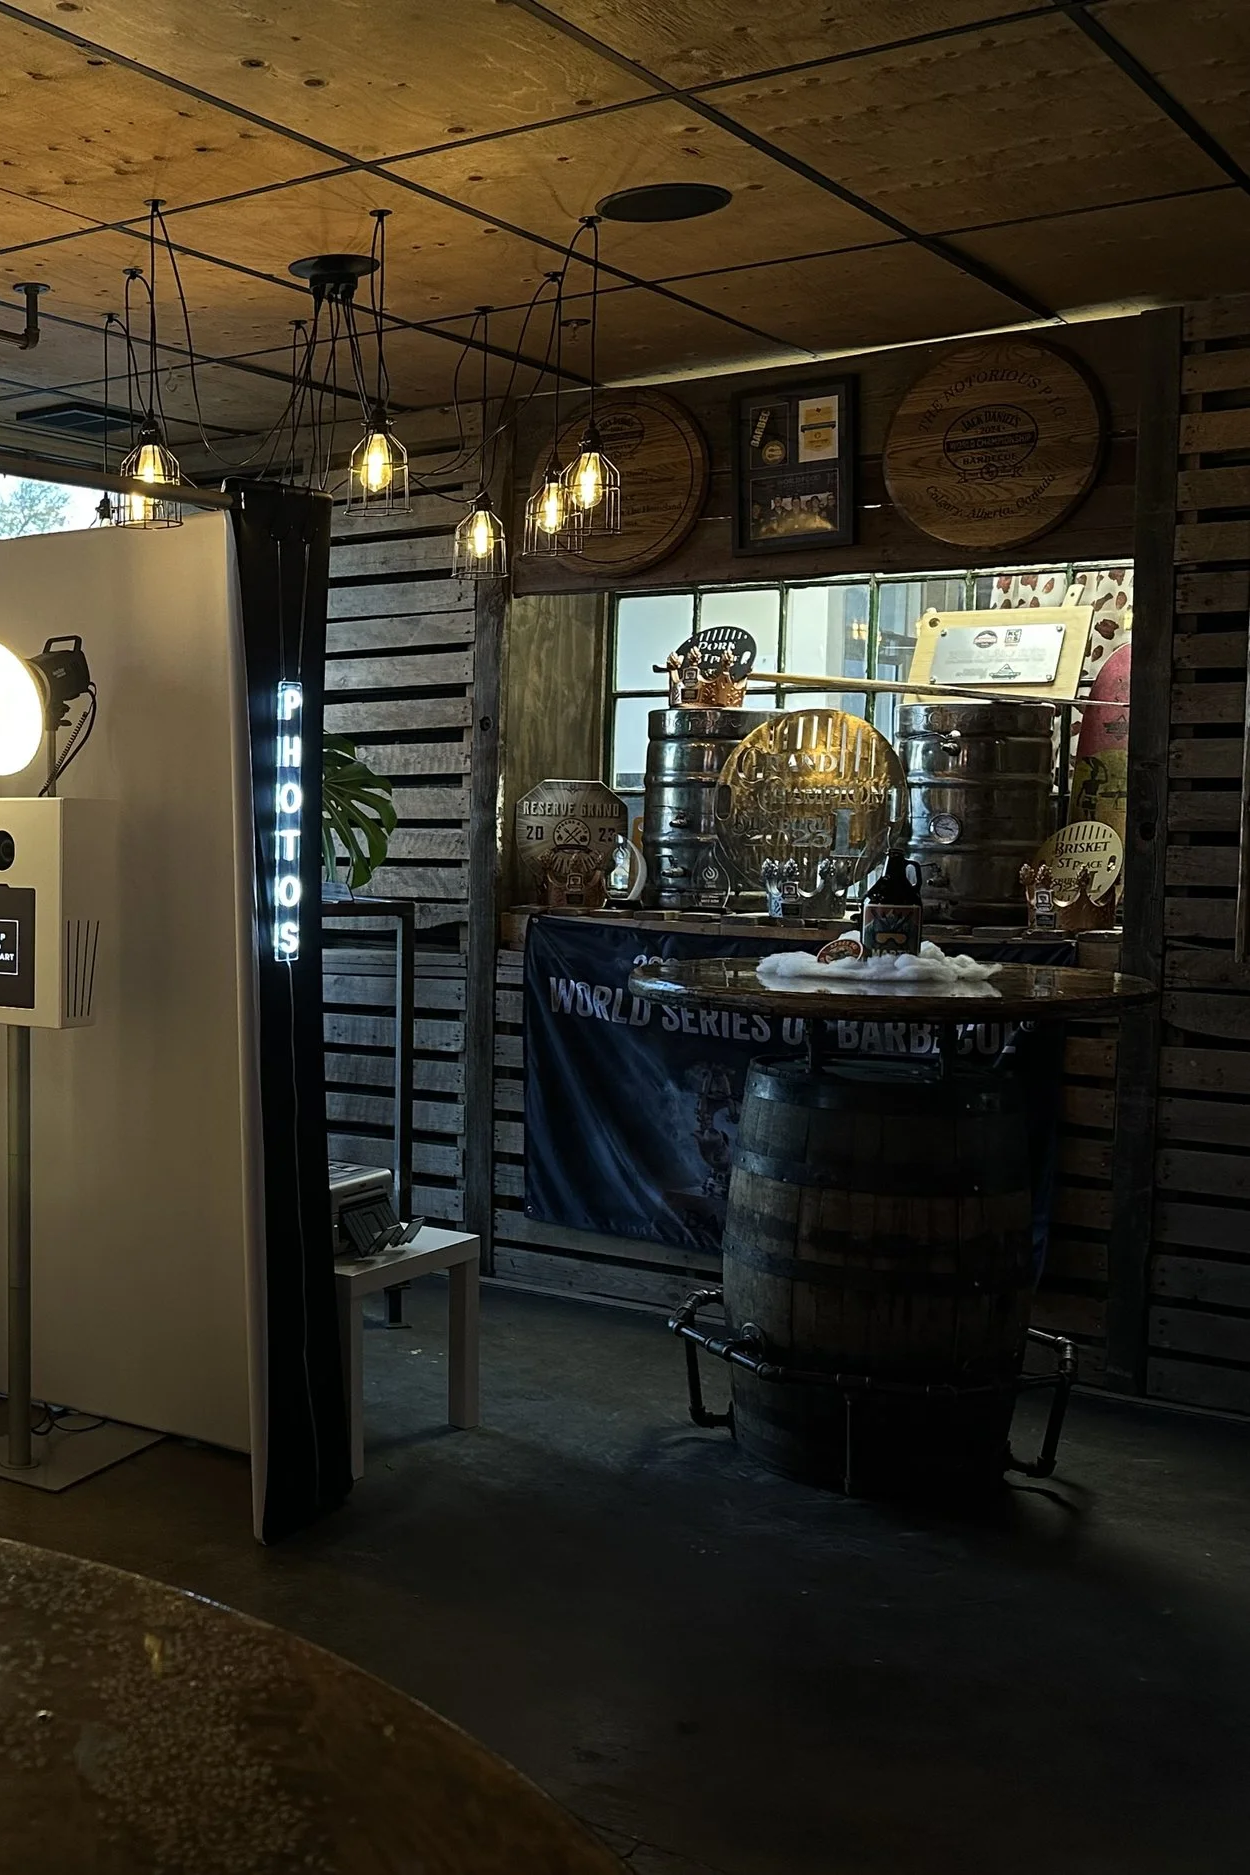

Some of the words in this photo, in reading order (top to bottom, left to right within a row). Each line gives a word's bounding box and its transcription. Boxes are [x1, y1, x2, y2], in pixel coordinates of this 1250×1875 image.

[918, 400, 944, 433] THE
[944, 368, 1042, 402] NOTORIOUS
[736, 745, 838, 784] GRAND
[523, 800, 576, 817] RESERVE
[580, 802, 622, 818] GRAND
[758, 776, 886, 814] CHAMPION
[277, 688, 302, 954] PHOTOS
[526, 826, 545, 840] 20
[1054, 841, 1111, 858] BRISKET
[548, 976, 652, 1027] WORLD
[661, 1002, 772, 1043] SERIES
